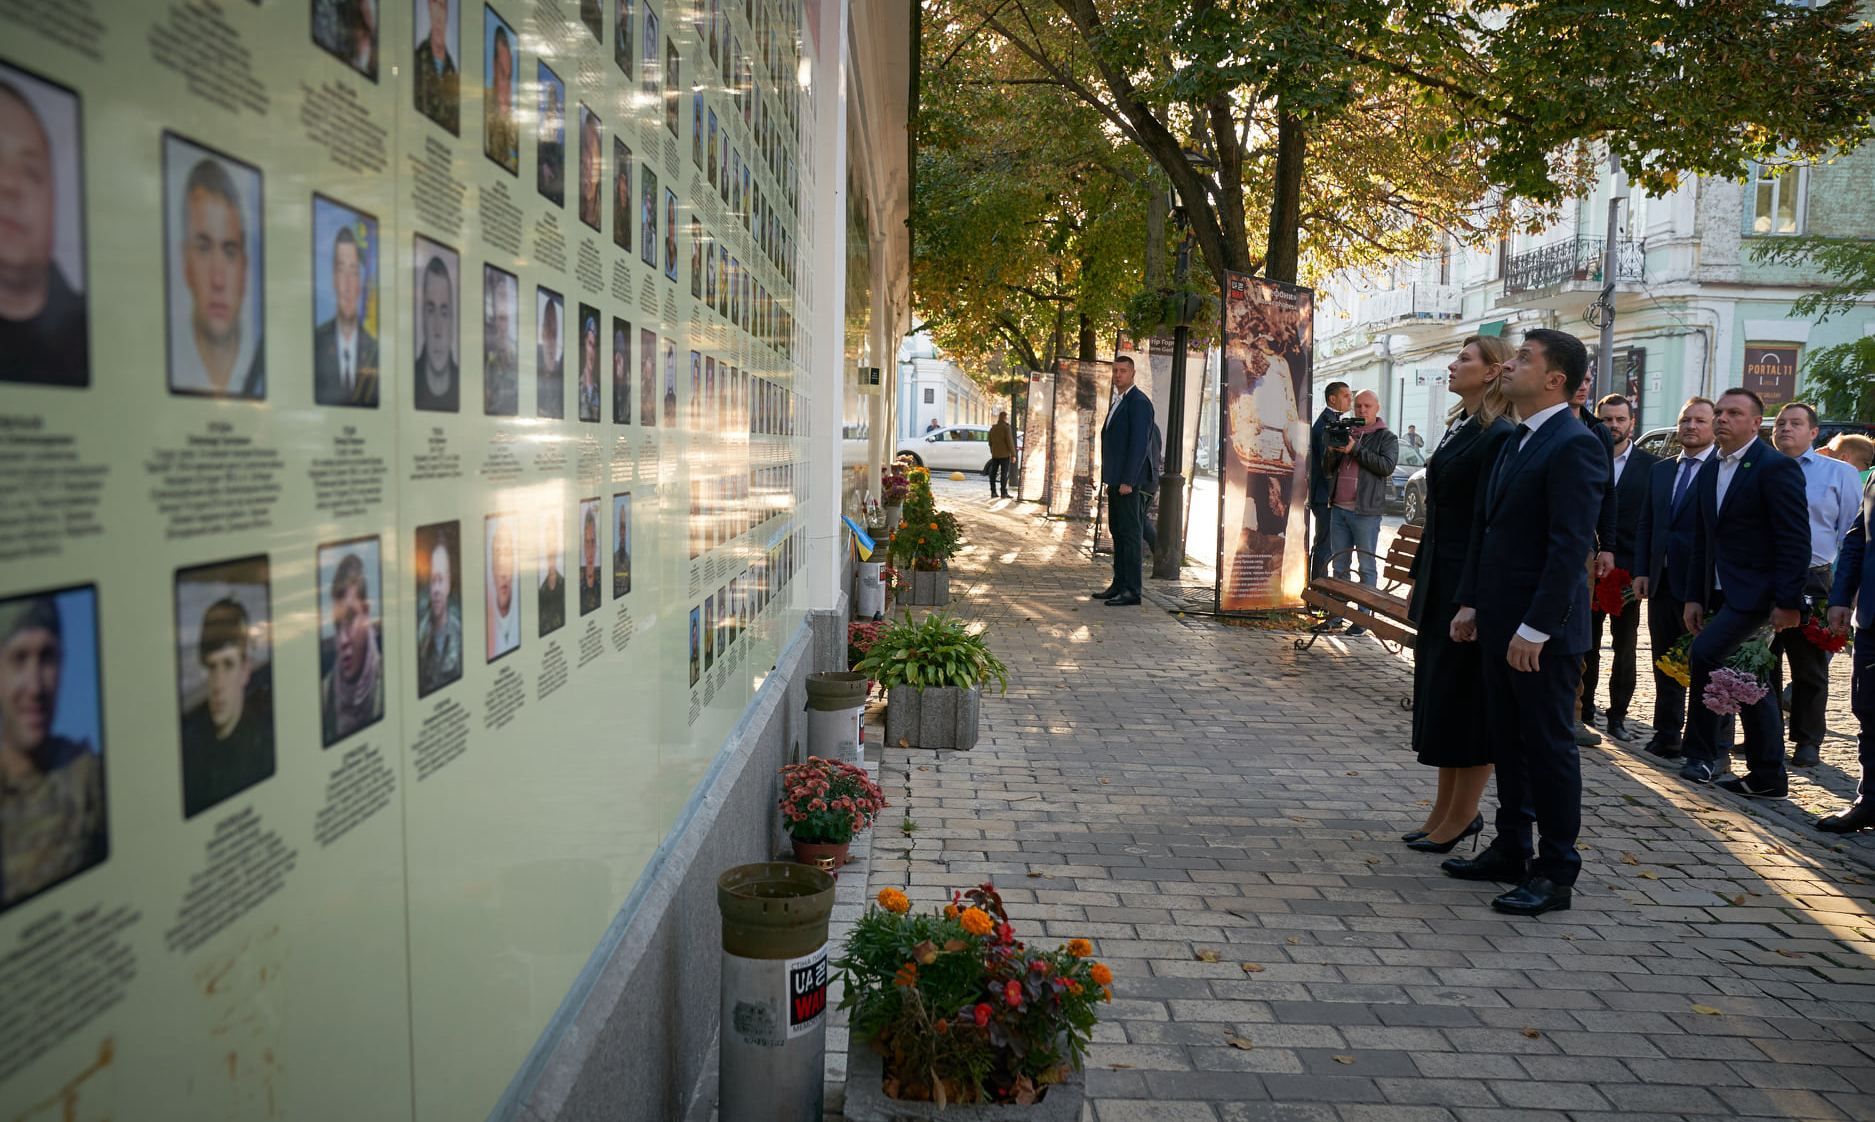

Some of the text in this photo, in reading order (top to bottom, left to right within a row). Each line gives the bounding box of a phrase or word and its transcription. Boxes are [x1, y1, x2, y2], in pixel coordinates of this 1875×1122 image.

[1748, 364, 1793, 376] PORTAL 11
[795, 969, 814, 994] UA
[815, 960, 826, 987] RU
